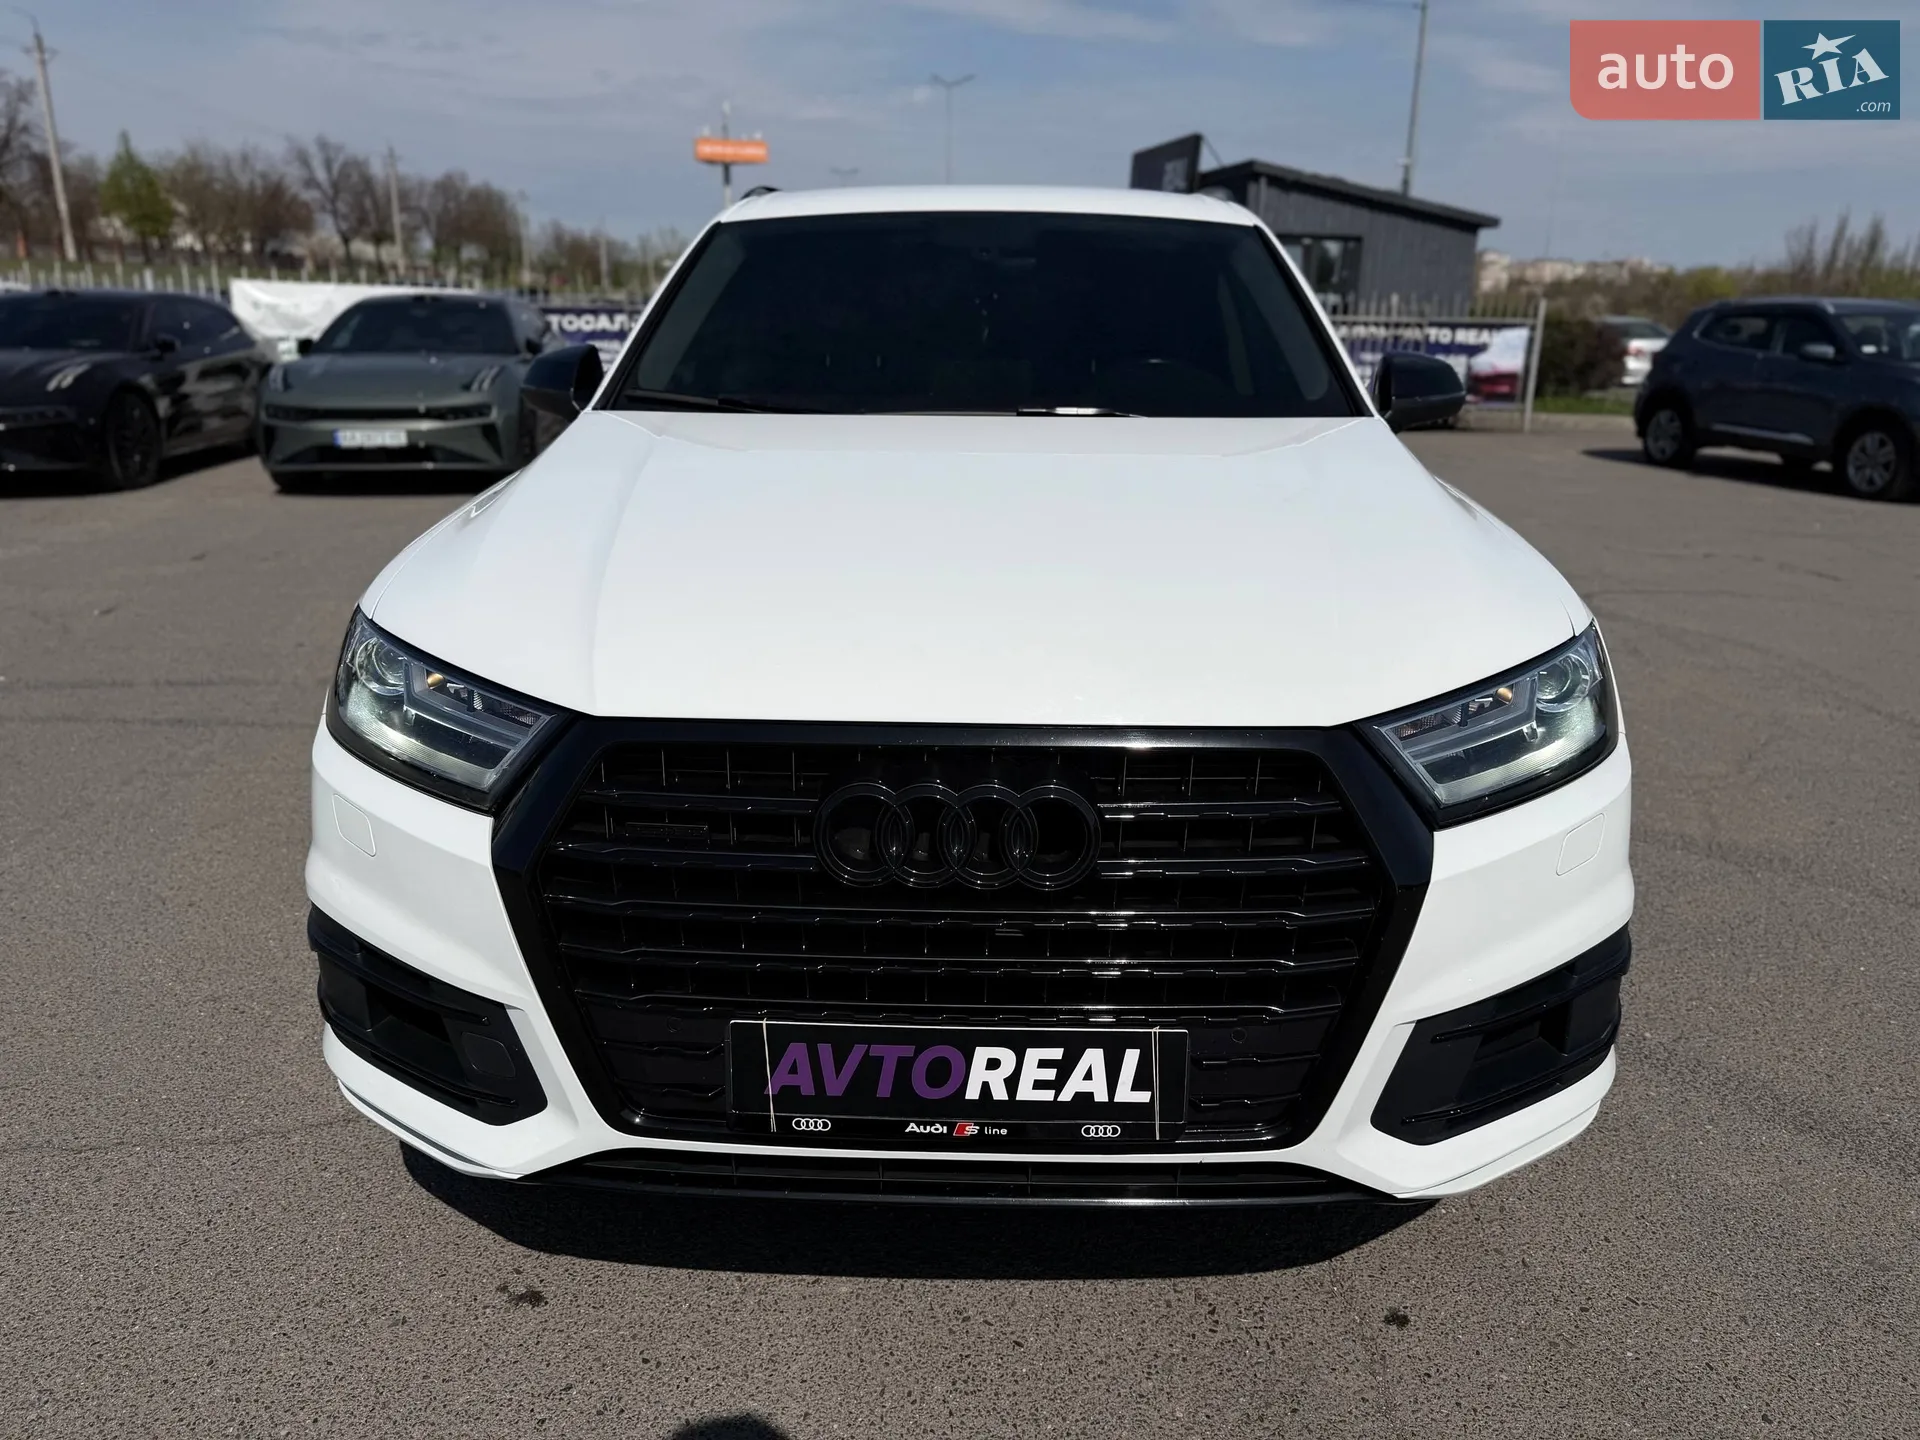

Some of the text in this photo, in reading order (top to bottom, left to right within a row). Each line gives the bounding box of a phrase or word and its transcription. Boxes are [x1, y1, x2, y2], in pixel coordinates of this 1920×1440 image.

[545, 312, 637, 333] ТОСАЛ
[763, 1042, 1153, 1103] AVTOREAL
[904, 1122, 948, 1134] Audi
[984, 1126, 1008, 1136] line
